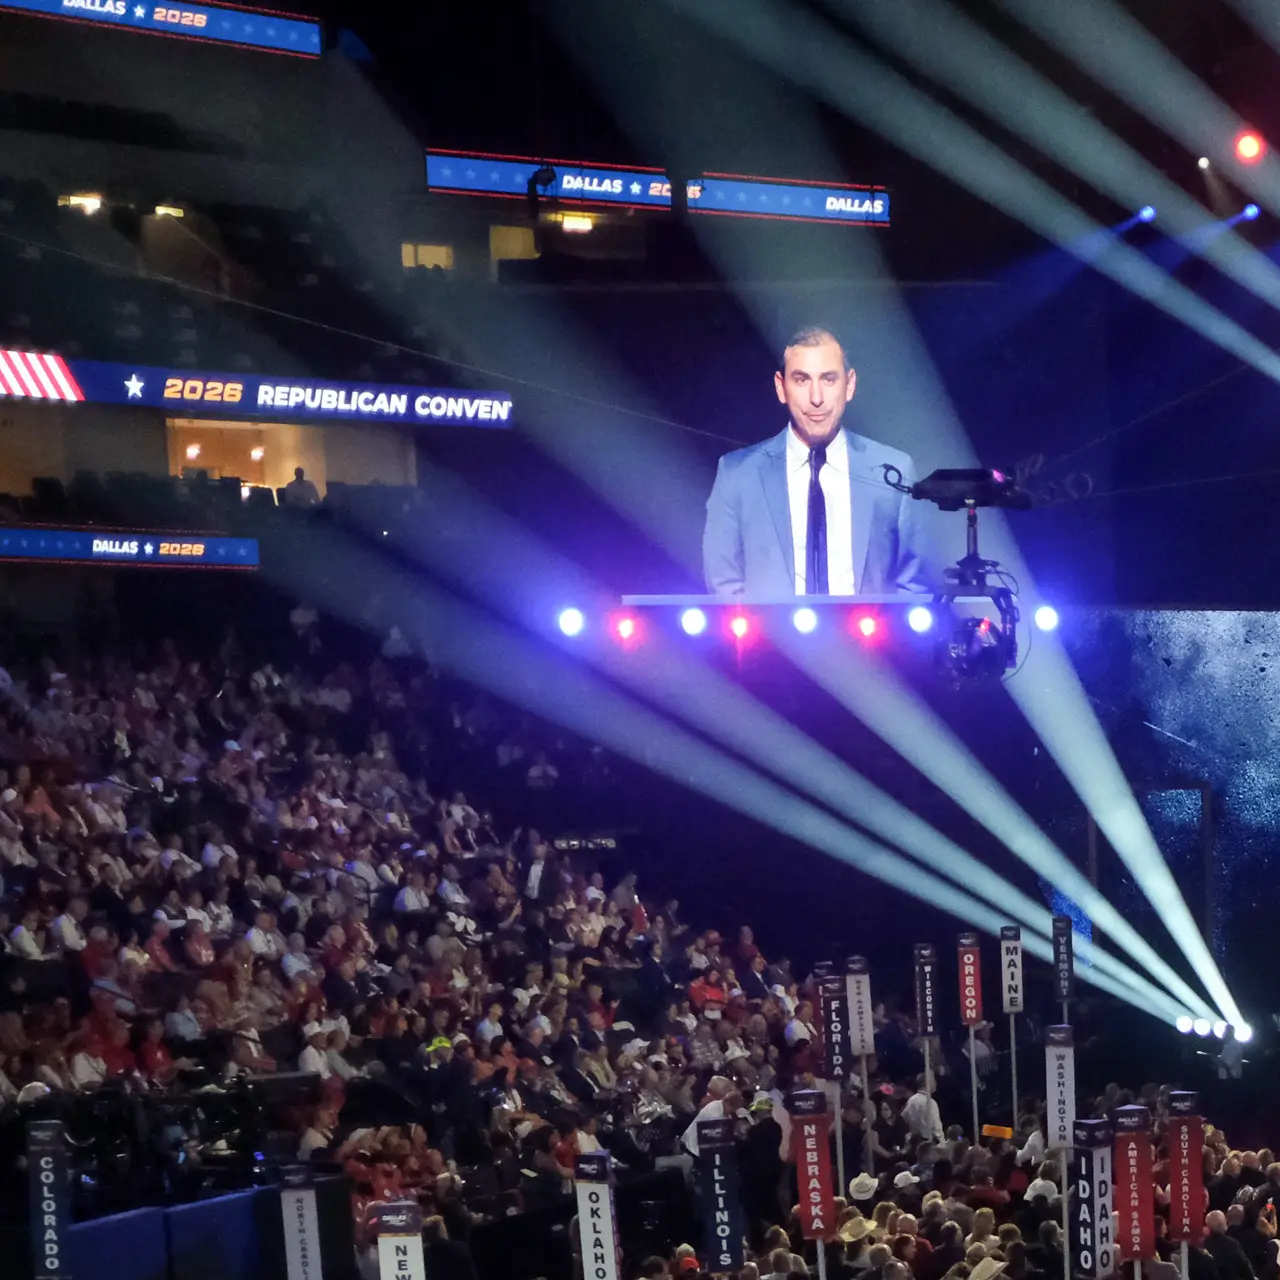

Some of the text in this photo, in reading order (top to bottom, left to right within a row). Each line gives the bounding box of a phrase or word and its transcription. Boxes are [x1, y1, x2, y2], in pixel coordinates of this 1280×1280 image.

[153, 7, 207, 27] 2026
[562, 175, 623, 193] DALLAS
[825, 197, 884, 213] DALLAS
[164, 378, 513, 420] 2026 REPUBLICAN CONVEN
[92, 539, 205, 556] DALLAS 2026
[924, 965, 933, 1032] WISCONSIN
[964, 954, 976, 1019] OREGON
[1005, 946, 1020, 1007] MAINE
[1058, 936, 1068, 996] VERMONT
[831, 1000, 844, 1076] FLORIDA
[1055, 1053, 1067, 1142] WASHINGTON
[714, 1154, 732, 1266] ILLINOIS
[804, 1124, 825, 1230] NEBRASKA
[1098, 1155, 1111, 1268] IDAHO
[1128, 1141, 1141, 1252] AMERICAN SAMOA
[1181, 1125, 1190, 1233] SOUTH CAROLINA
[40, 1156, 59, 1270] COLORADO
[1078, 1156, 1092, 1271] IDAHO
